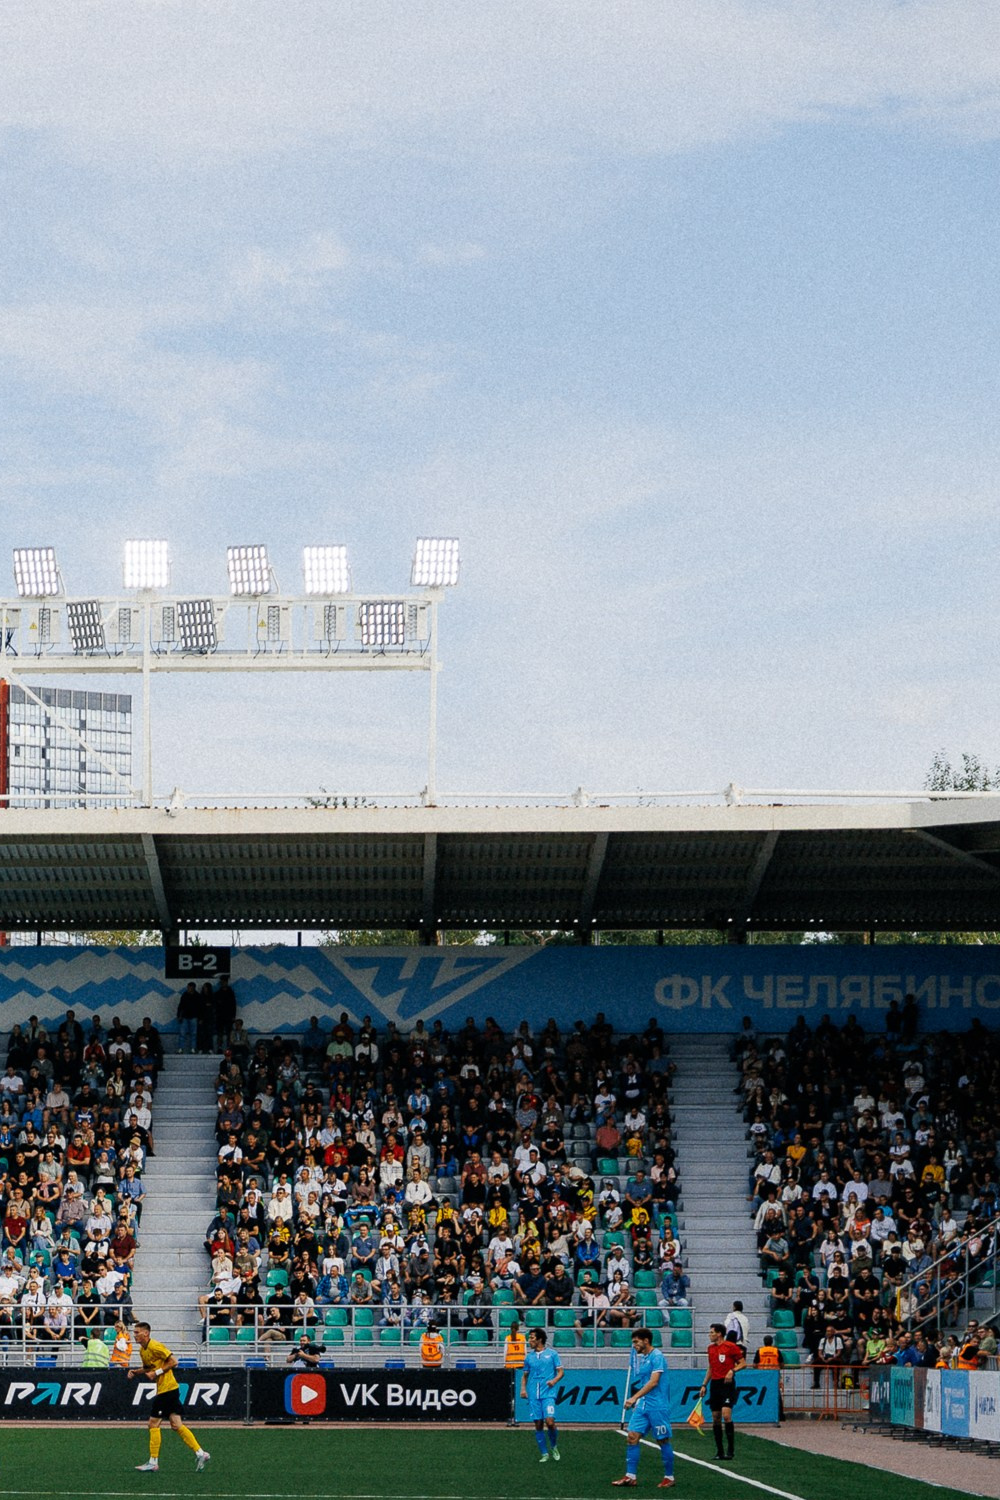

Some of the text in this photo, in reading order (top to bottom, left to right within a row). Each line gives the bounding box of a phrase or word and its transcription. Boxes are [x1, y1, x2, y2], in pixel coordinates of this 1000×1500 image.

[654, 974, 733, 1009] ФК
[4, 1382, 102, 1405] PARI
[340, 1383, 477, 1411] VK Видео
[554, 1385, 768, 1406] ИГА PRI
[655, 1425, 667, 1436] 70
